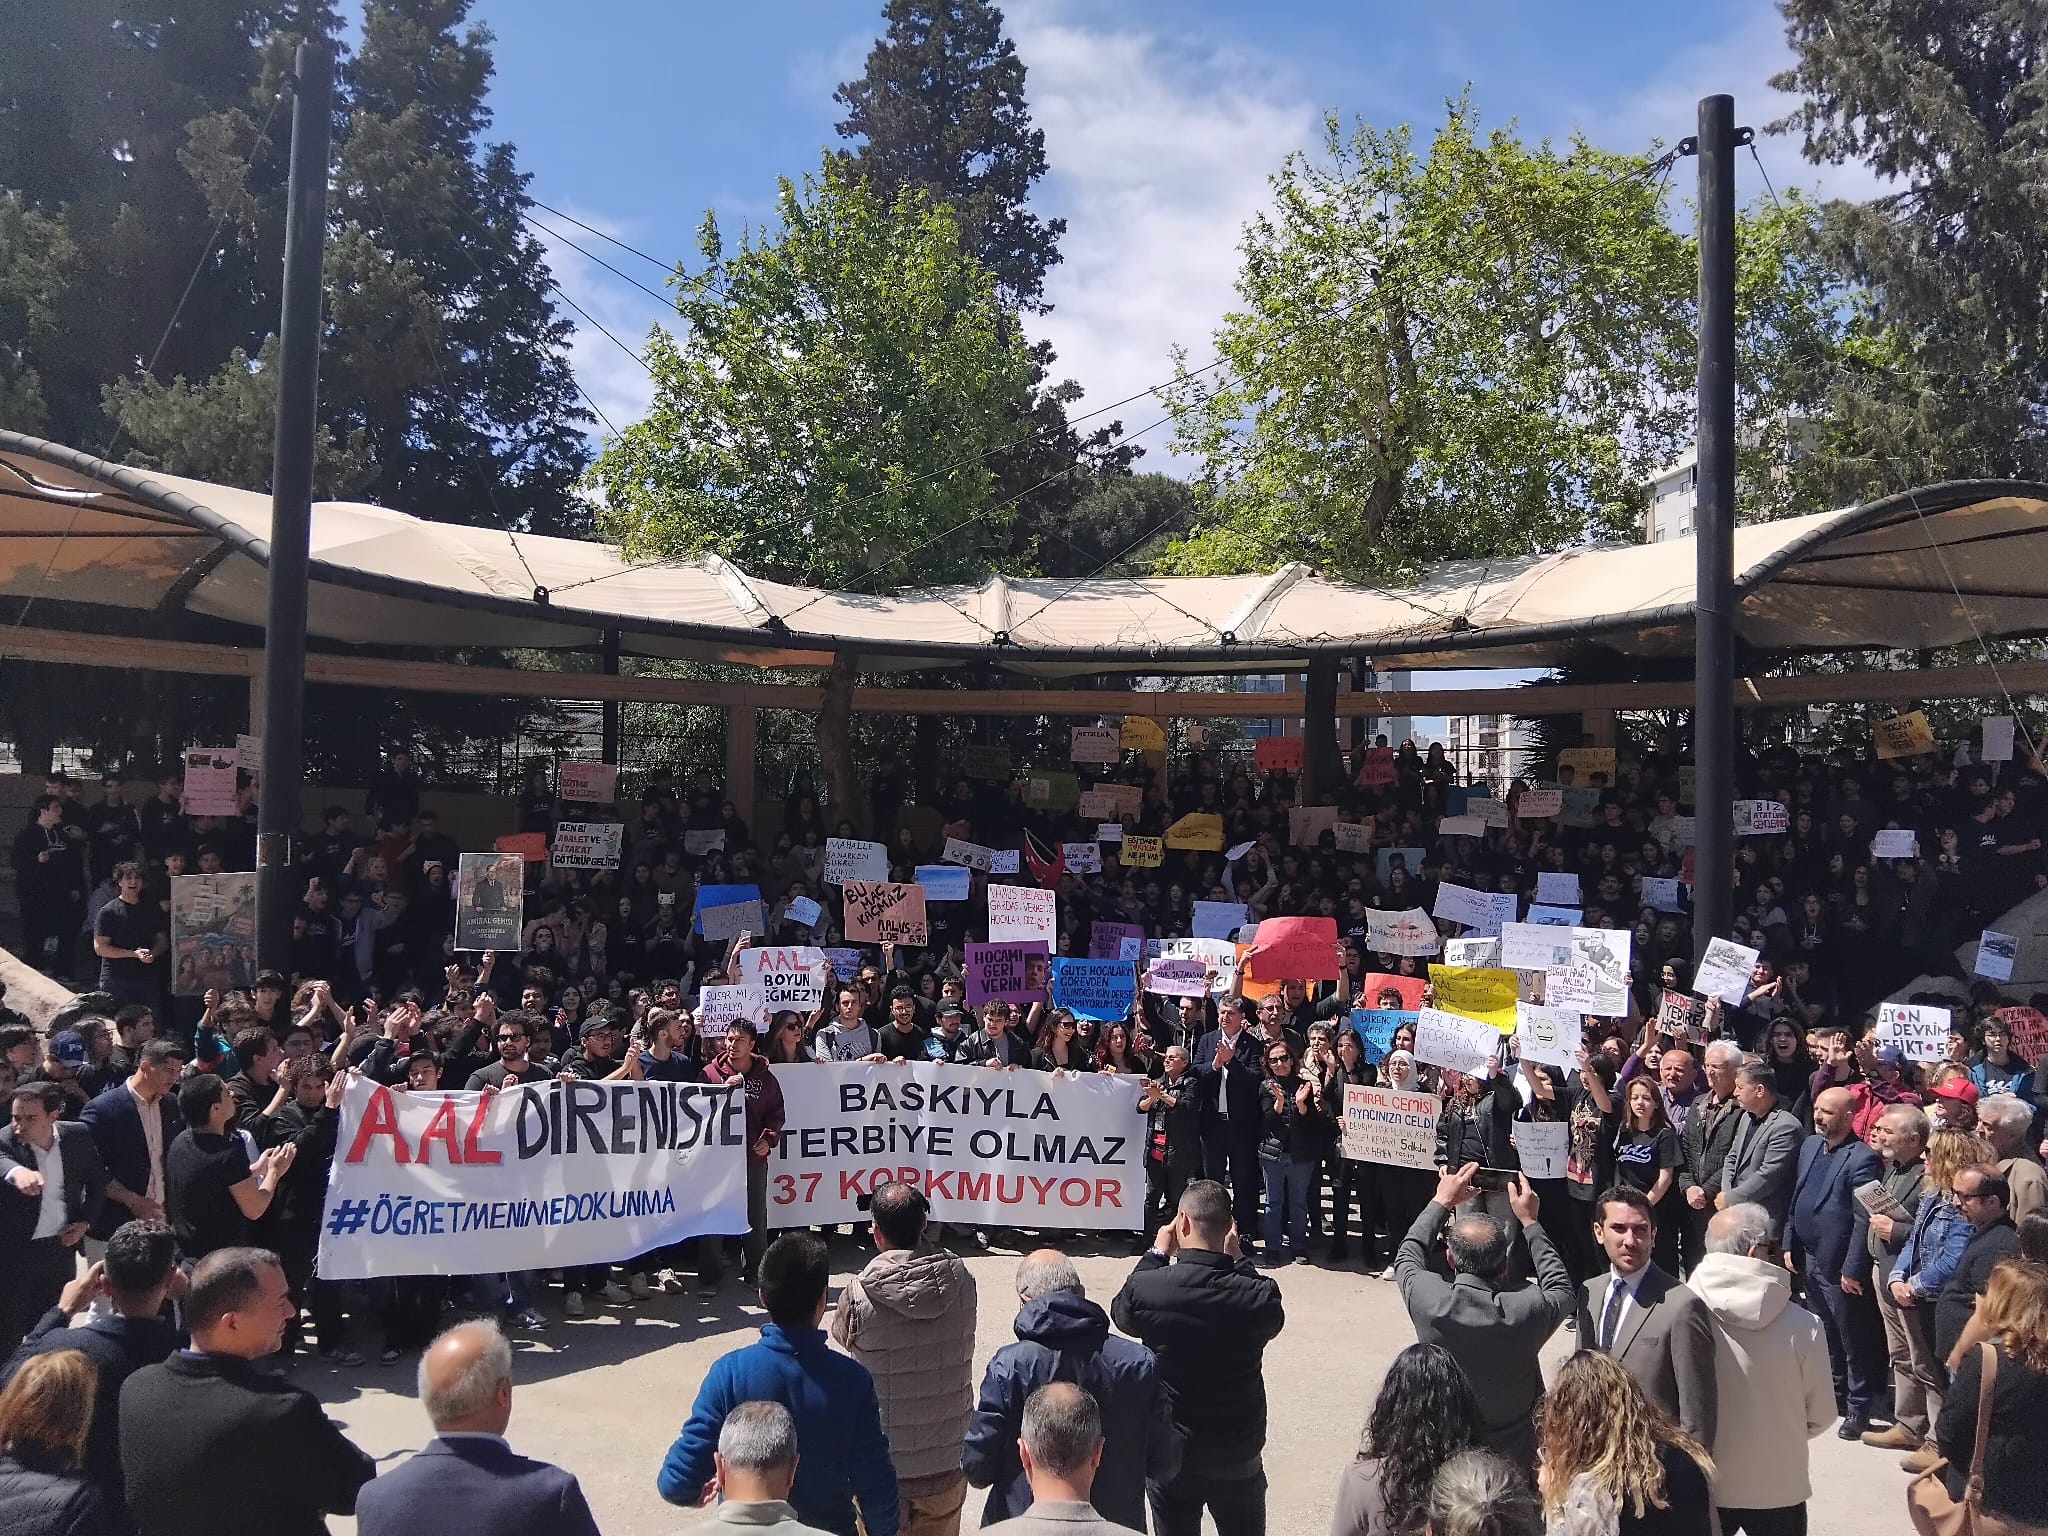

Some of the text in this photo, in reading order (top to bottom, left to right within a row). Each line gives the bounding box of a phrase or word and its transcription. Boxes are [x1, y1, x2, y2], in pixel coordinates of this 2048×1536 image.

[559, 823, 577, 833] BEN
[557, 834, 602, 844] ADALET VE
[826, 841, 873, 851] MAHALLE
[845, 882, 868, 905] BU
[861, 884, 886, 911] MAÇ
[989, 886, 1018, 900] NAMUS
[856, 885, 907, 928] KAÇMAZ
[878, 932, 899, 942] 105
[758, 950, 811, 973] AAL
[974, 949, 1023, 965] HOCAMI
[1060, 965, 1087, 977] GUYS
[764, 973, 811, 987] BOYUN
[1111, 988, 1135, 1000] DERSE
[704, 1001, 743, 1013] ANTALYA
[1892, 1021, 1950, 1037] DEVRİM
[1418, 1043, 1434, 1060] NE
[839, 1082, 1061, 1121] BASKIYLA
[1348, 1090, 1390, 1108] AMİRAL
[345, 1085, 503, 1166] AAL
[778, 1117, 1126, 1165] TERBİYE OLMAZ
[772, 1166, 1123, 1208] 37 KORKMUYOR
[326, 1186, 677, 1236] #ÖĞRETMENİMEDOKUNMA
